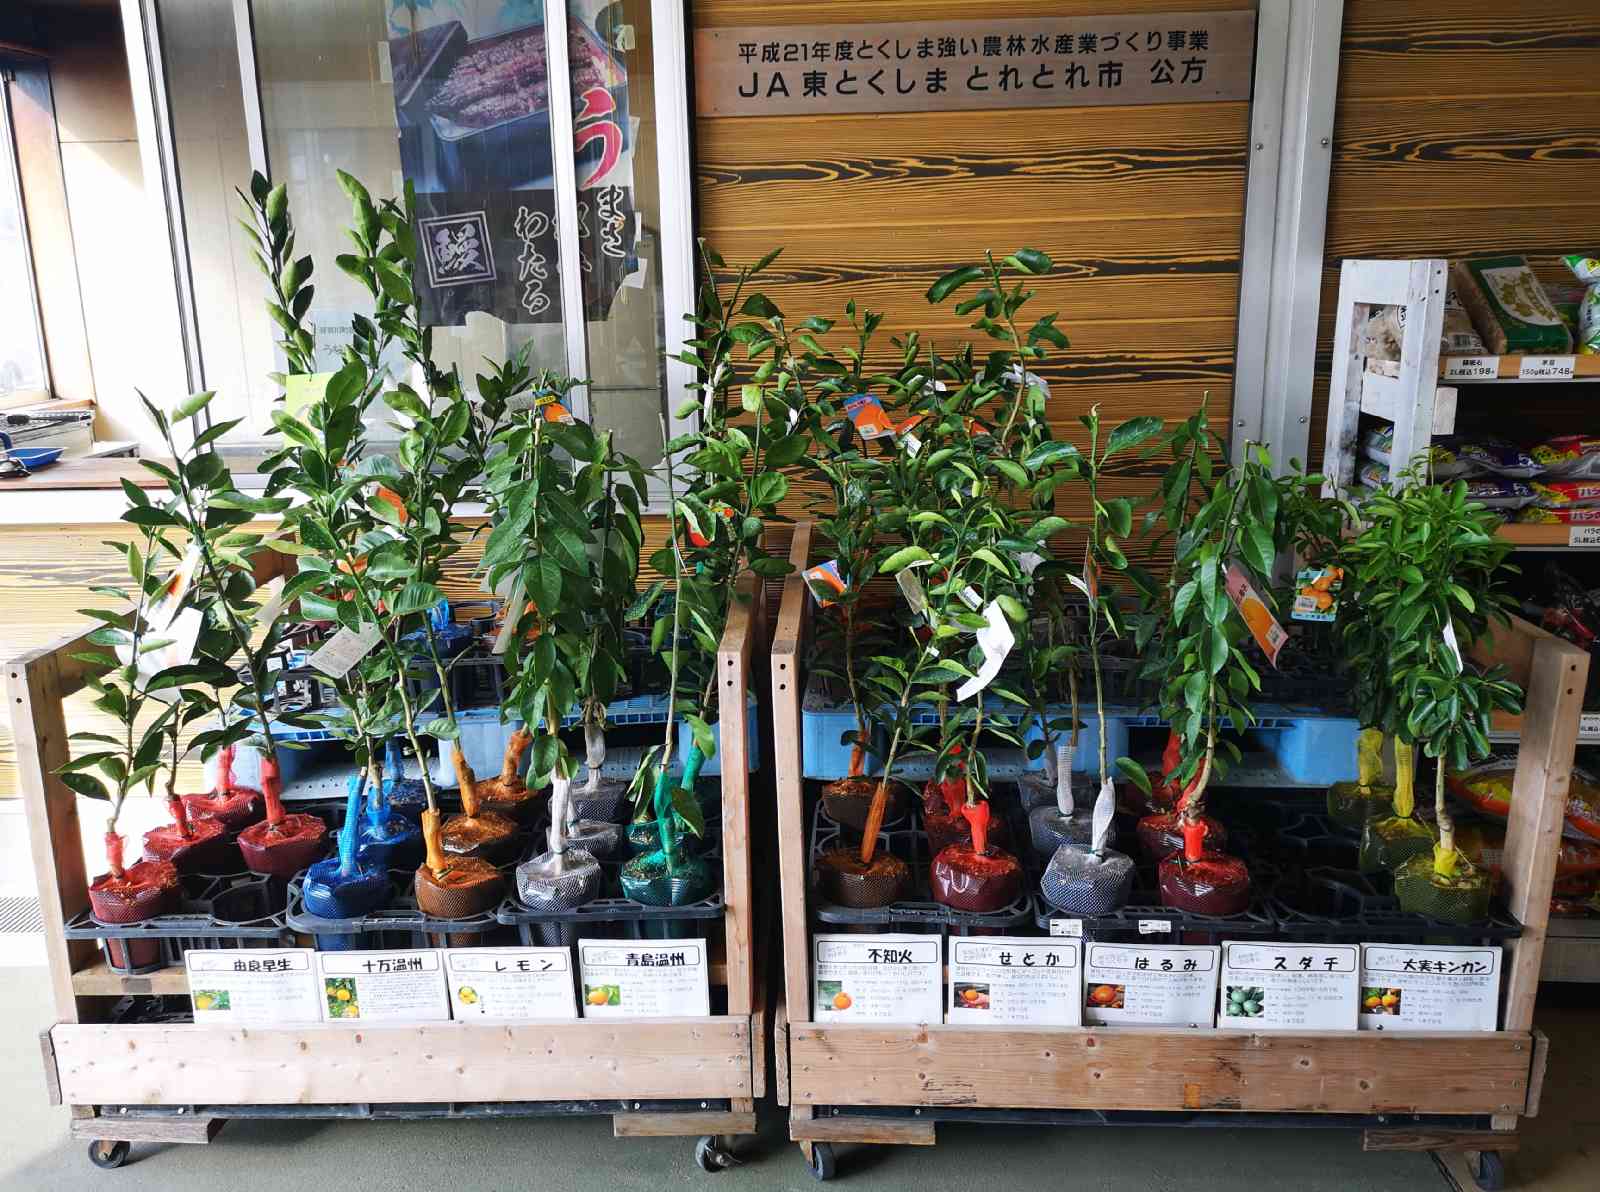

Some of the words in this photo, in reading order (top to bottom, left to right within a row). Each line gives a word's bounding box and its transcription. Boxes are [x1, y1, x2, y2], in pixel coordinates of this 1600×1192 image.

[738, 30, 1209, 64] 平成21年度とくしま強い農林水産業づくり事業
[966, 61, 1124, 92] とれとれ市
[1149, 56, 1208, 85] 公方
[514, 205, 551, 316] わたる
[625, 952, 685, 967] 青島温州
[868, 948, 912, 963] 不知火
[999, 951, 1060, 966] せとか
[233, 958, 294, 972] 由良早生
[362, 957, 423, 973] 十万温州
[495, 960, 552, 972] レモン
[1134, 957, 1197, 971] はるみ
[1274, 956, 1339, 971] スダチ
[1402, 958, 1487, 973] 大実キンカン
